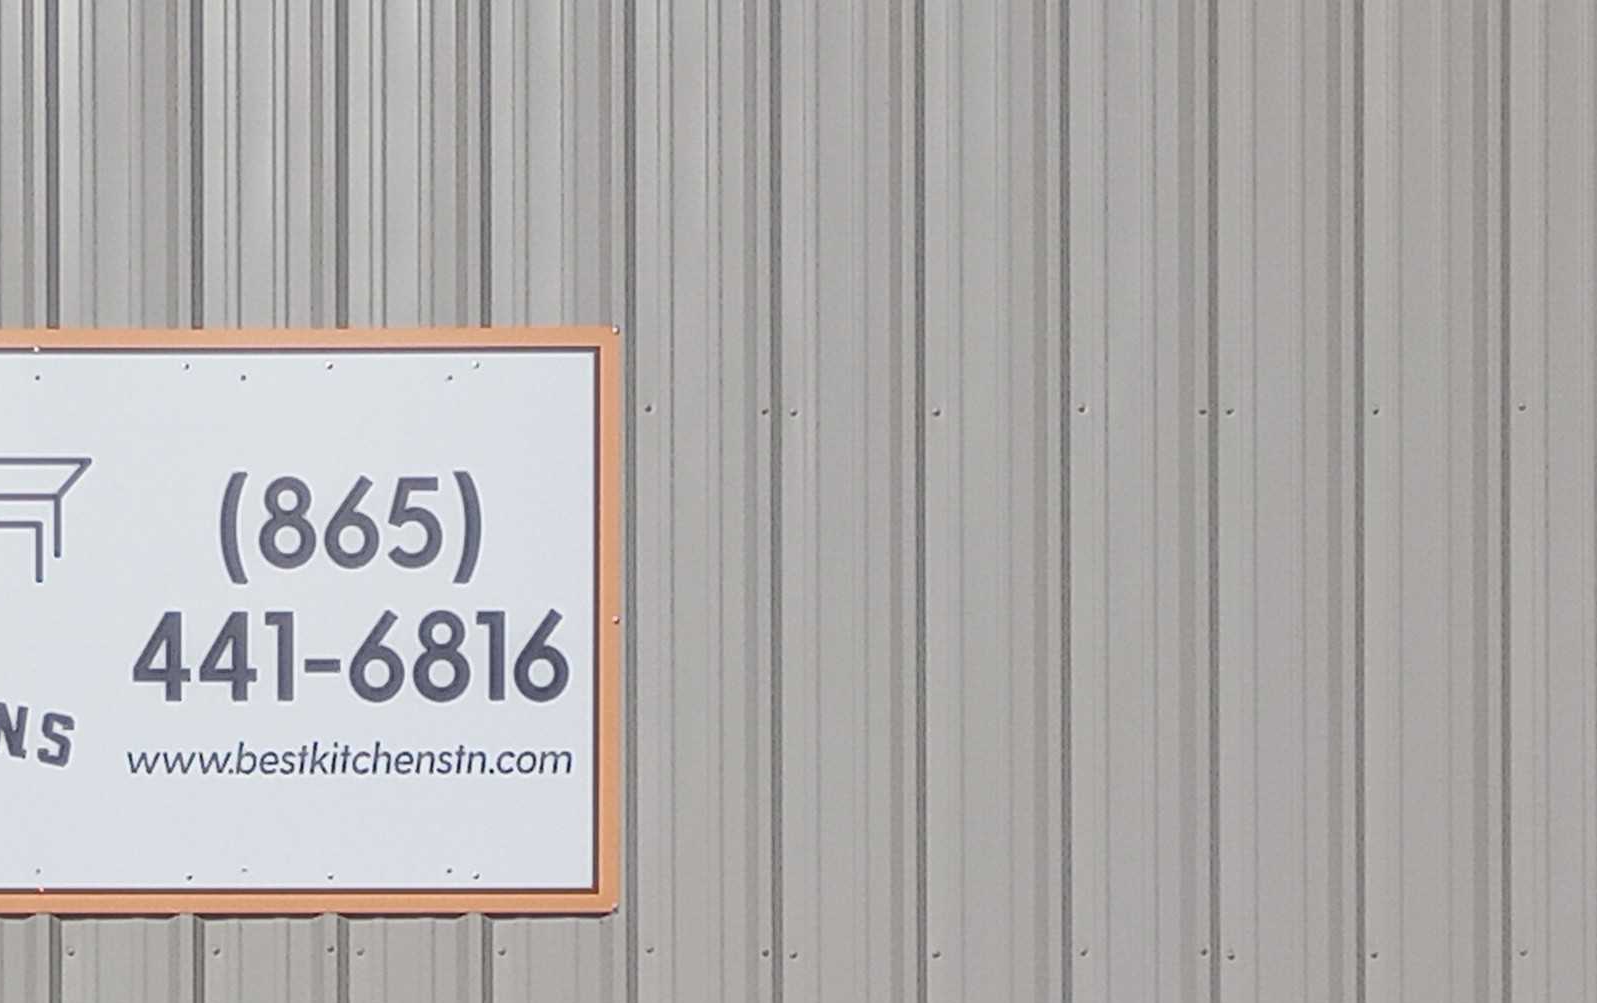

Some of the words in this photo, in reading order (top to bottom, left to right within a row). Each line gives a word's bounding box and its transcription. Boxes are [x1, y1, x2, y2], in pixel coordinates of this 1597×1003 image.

[219, 471, 482, 585] (865)
[132, 608, 570, 703] 441-6816
[126, 740, 573, 776] www.bestkitchenstn.com
